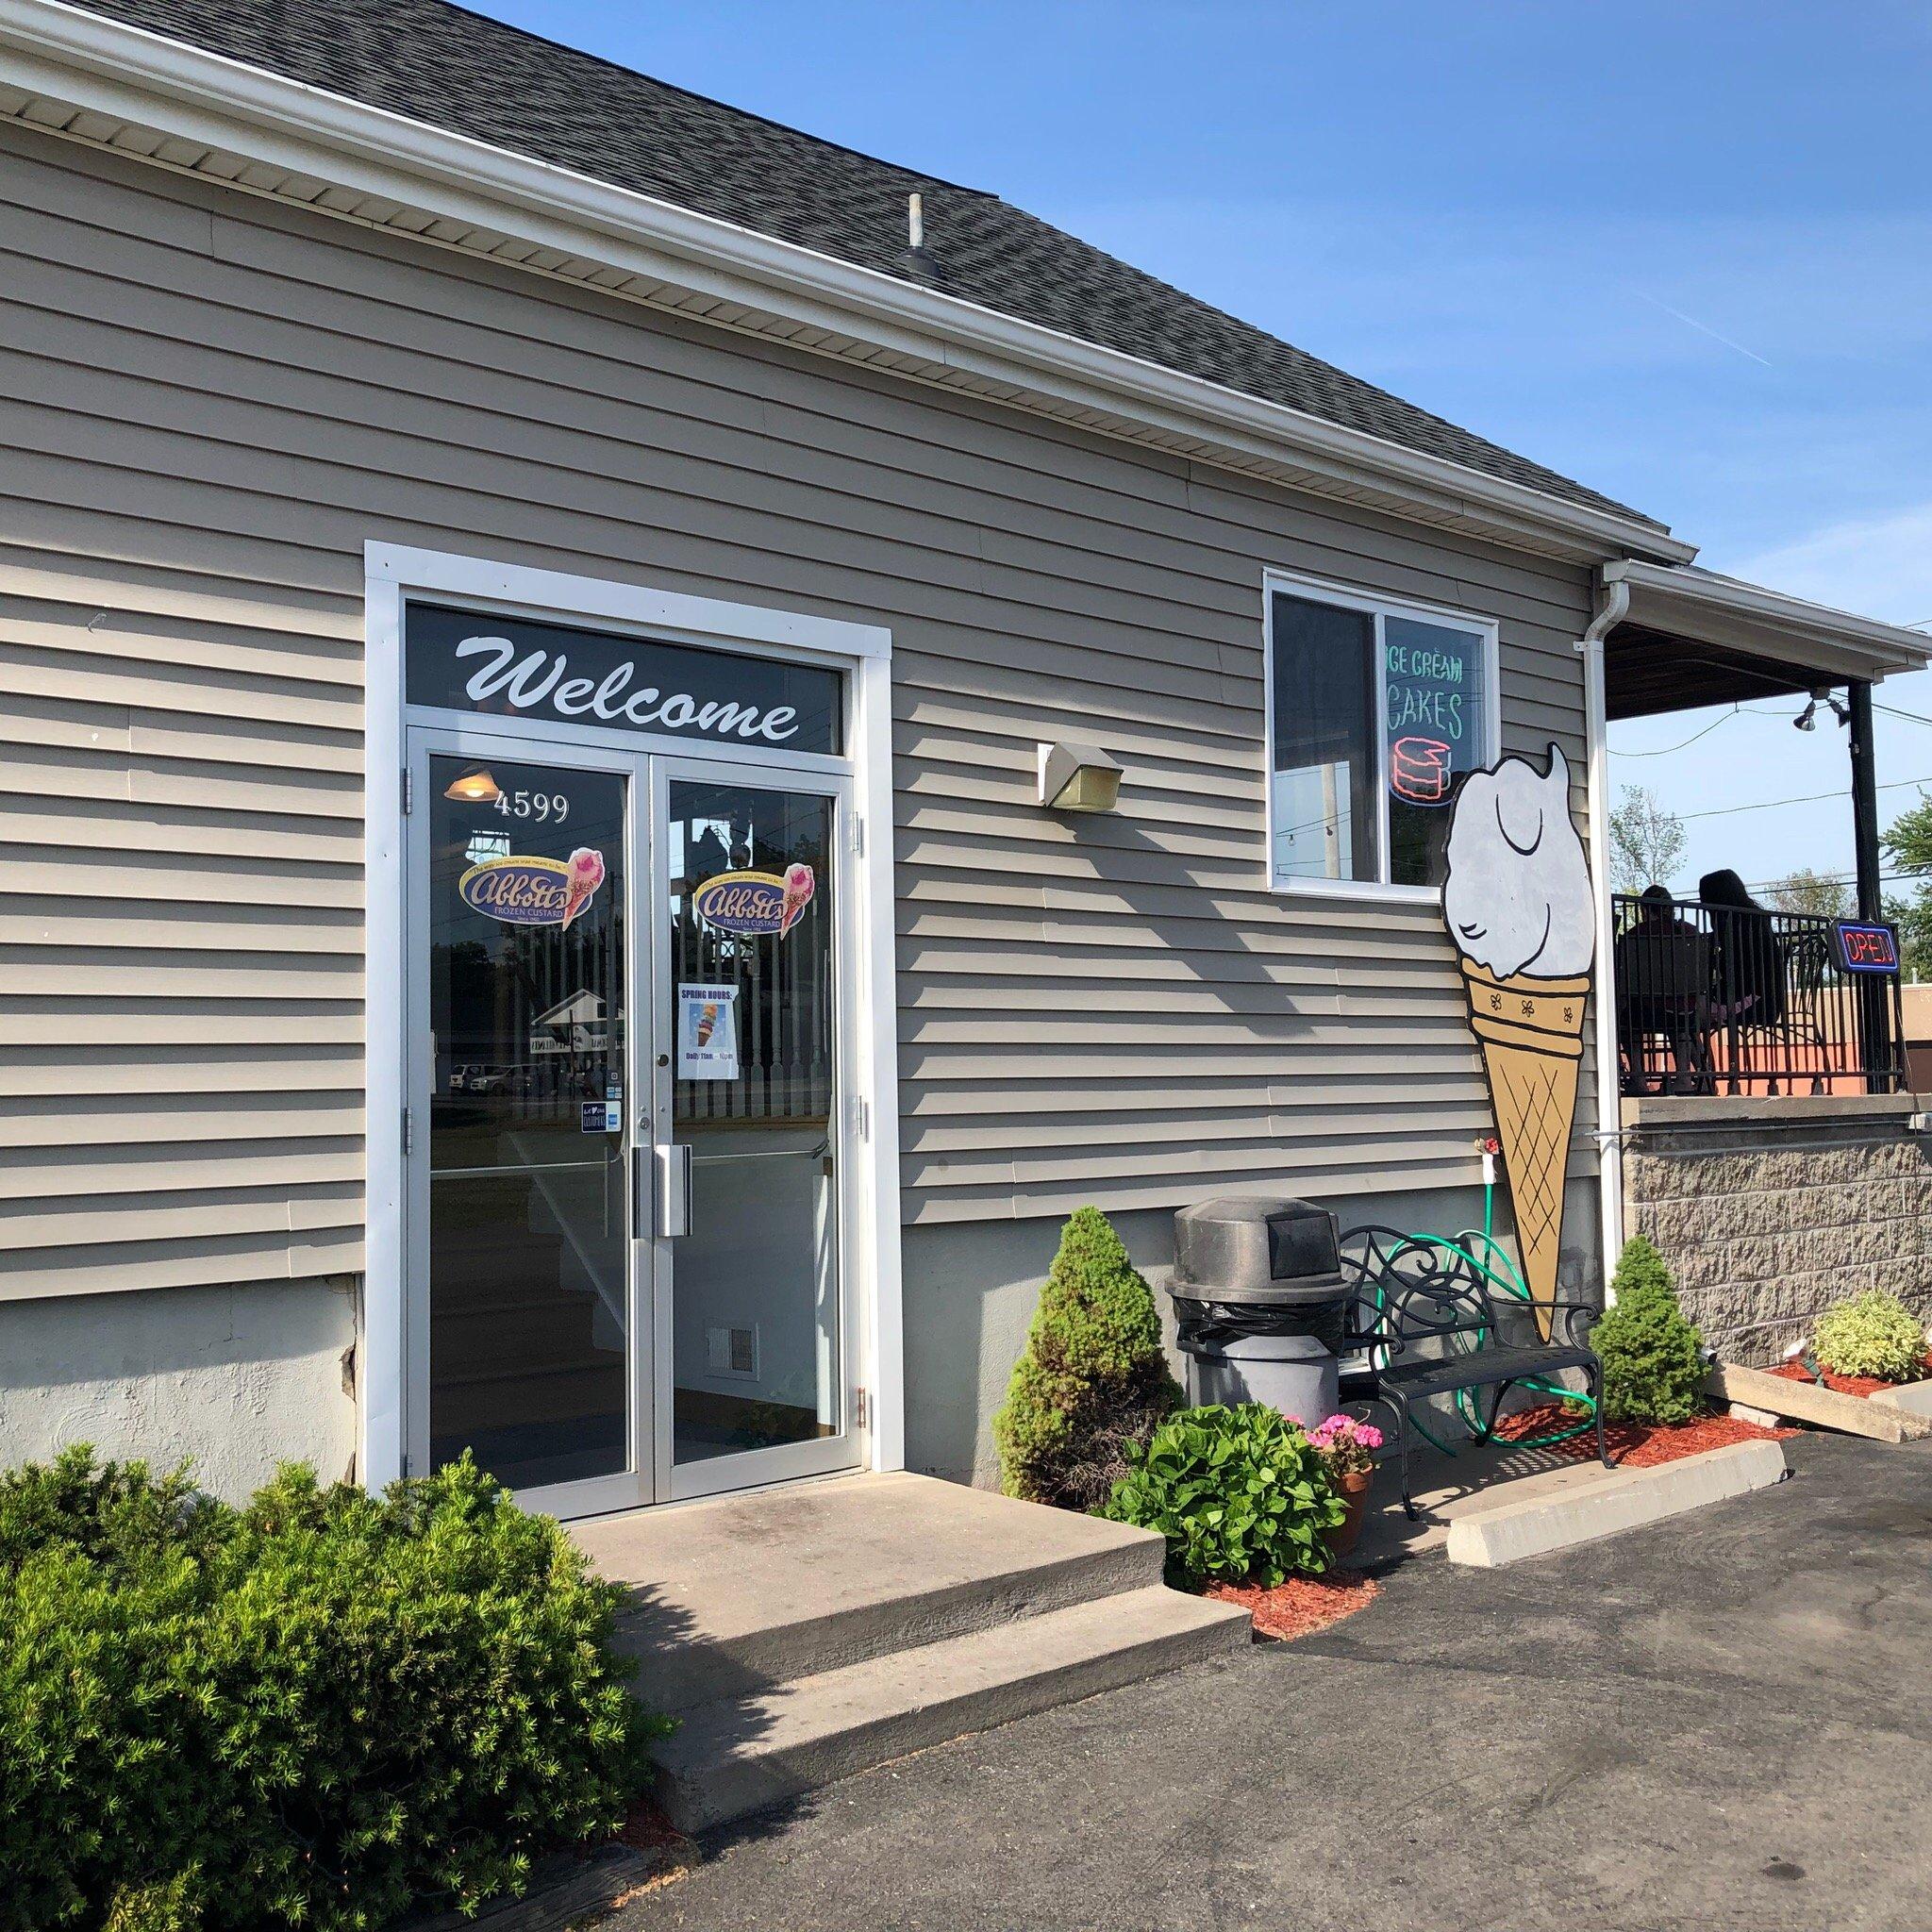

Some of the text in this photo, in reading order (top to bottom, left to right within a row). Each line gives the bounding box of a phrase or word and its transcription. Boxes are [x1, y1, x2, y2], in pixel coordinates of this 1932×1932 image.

[456, 636, 799, 741] Welcome
[1387, 685, 1462, 740] CAKES
[494, 790, 570, 824] 4599
[494, 907, 563, 918] FROZEN CUSTARD
[723, 918, 750, 926] FROZEN
[1845, 933, 1893, 962] OPEN
[681, 990, 732, 1000] SPRING HOURS:
